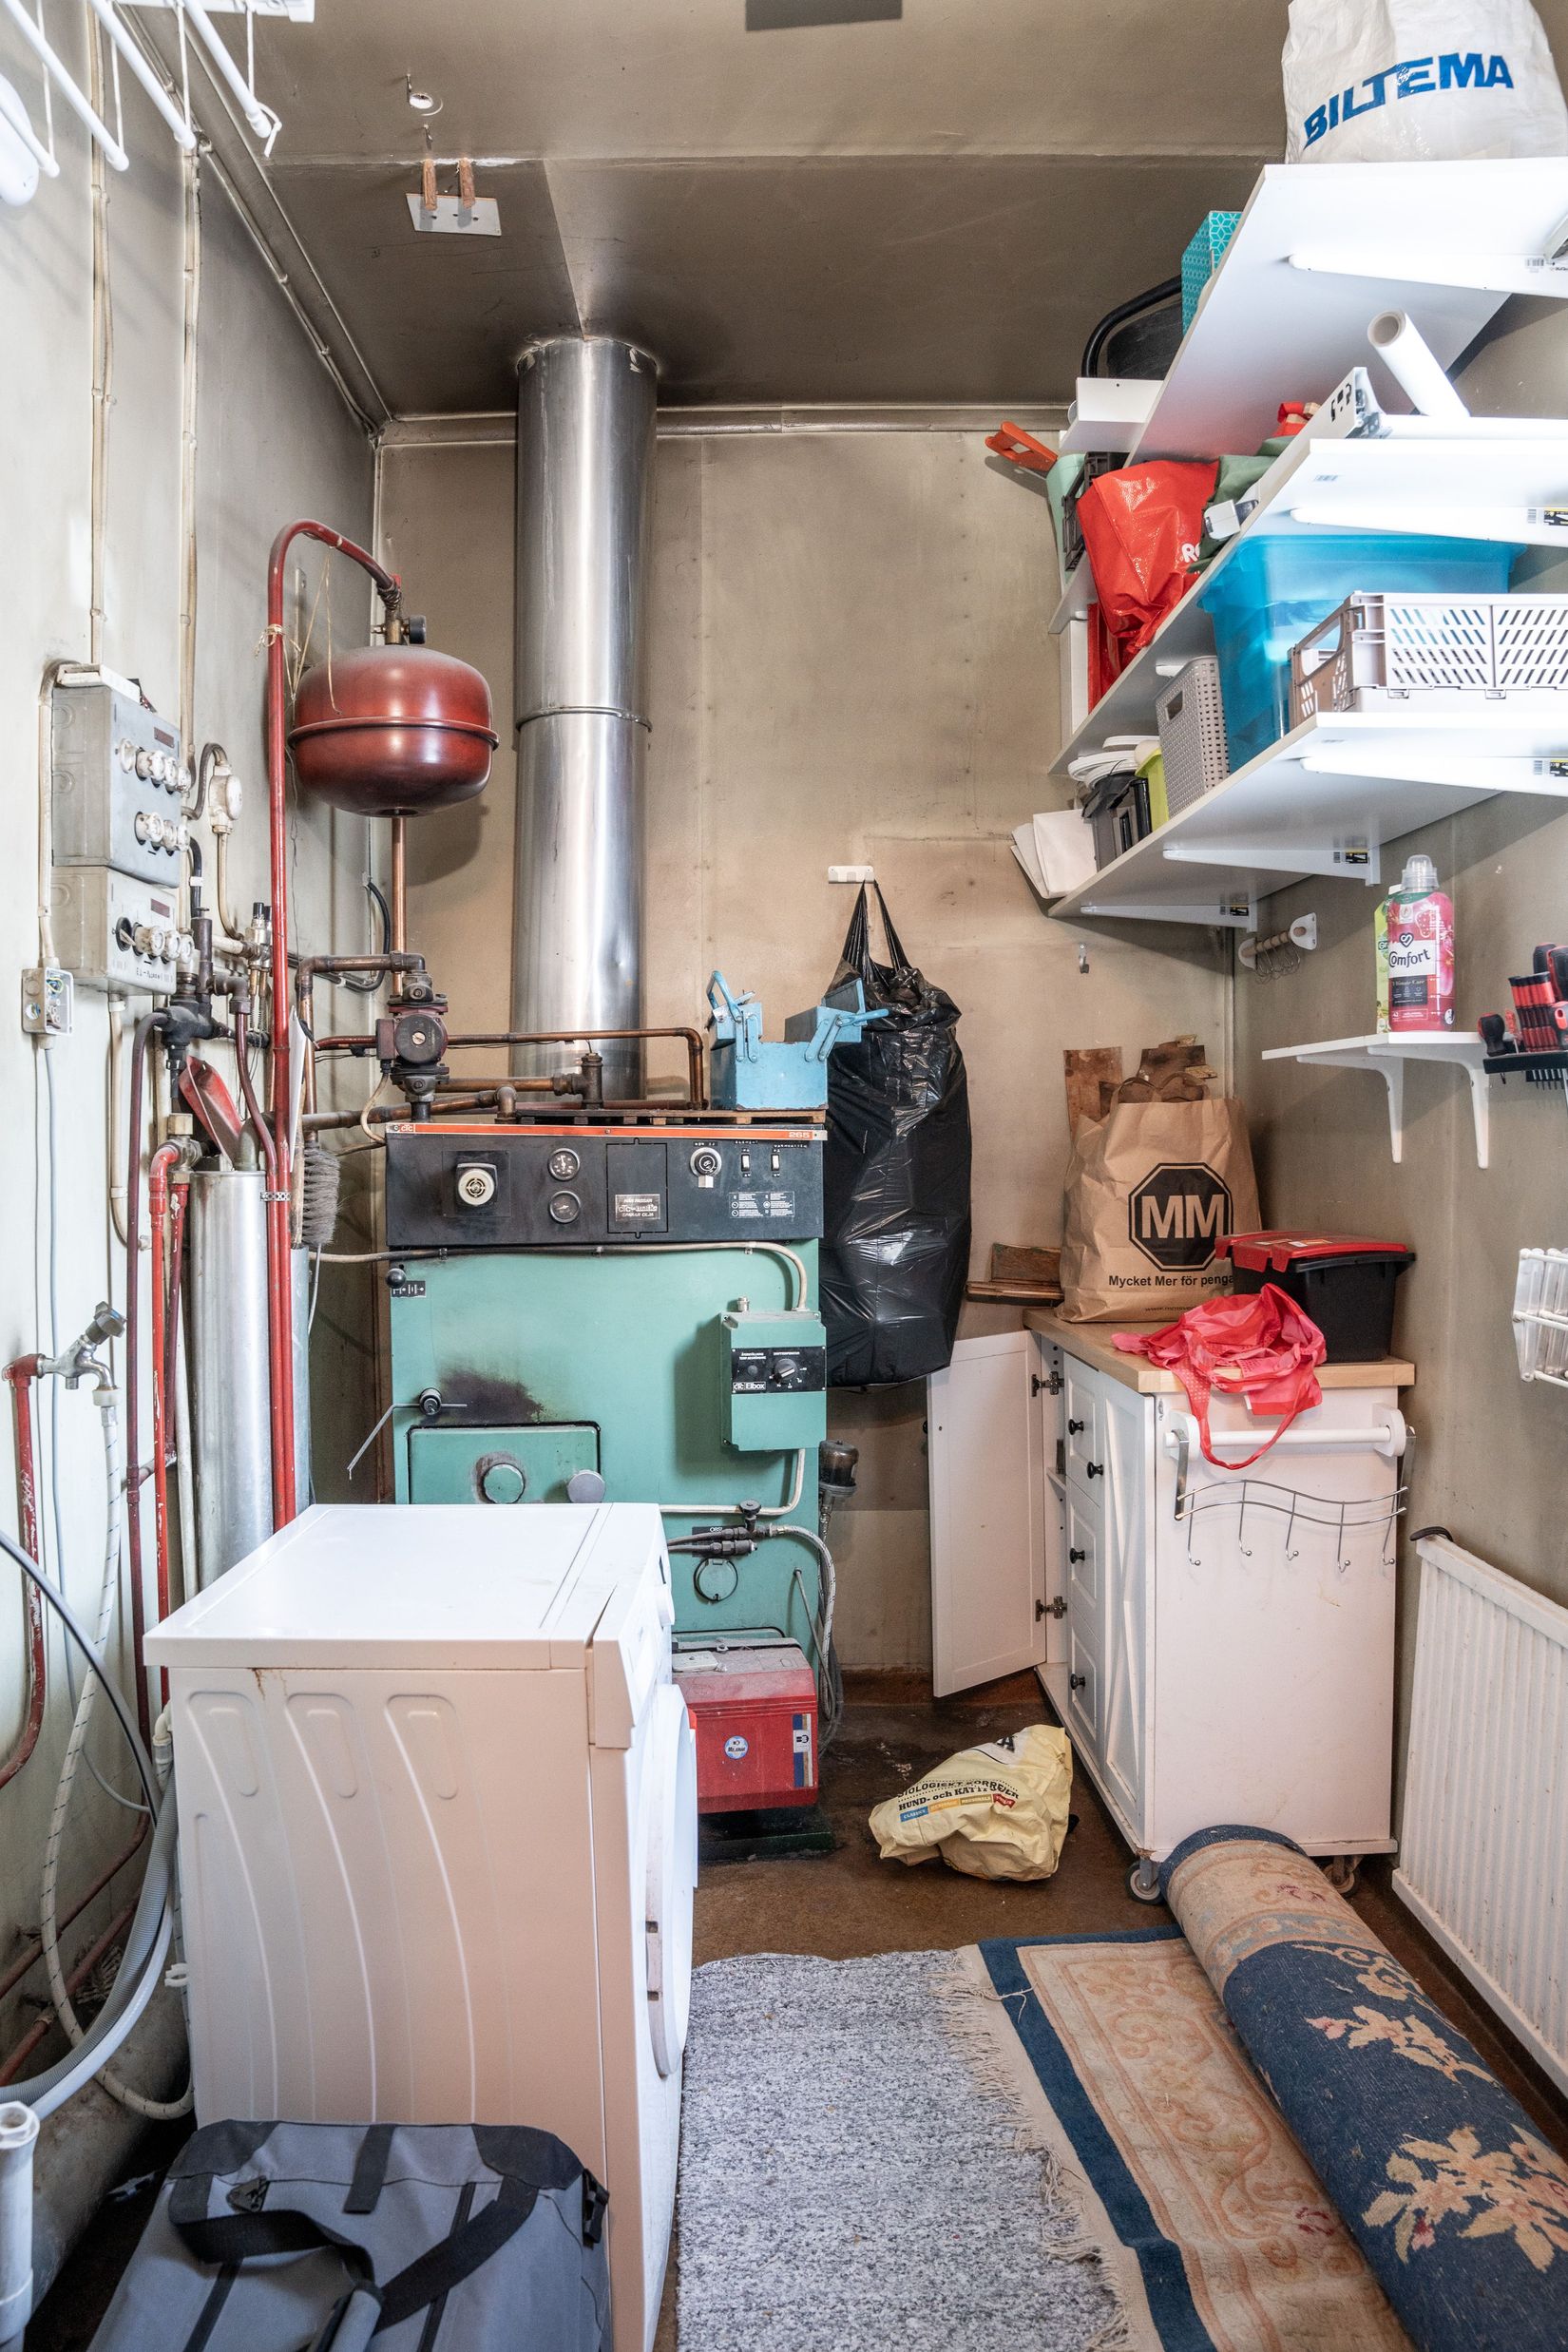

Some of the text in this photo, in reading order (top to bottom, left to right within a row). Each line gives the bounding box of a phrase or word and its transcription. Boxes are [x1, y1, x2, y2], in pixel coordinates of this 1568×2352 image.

[1303, 52, 1514, 150] BILTEMA
[1389, 948, 1430, 967] Comfort
[1141, 1194, 1225, 1239] MM
[1109, 1275, 1151, 1288] Mycket
[1155, 1275, 1177, 1286] Mer
[1180, 1275, 1197, 1286] för
[898, 1796, 930, 1811] HUND-
[932, 1790, 953, 1801] och
